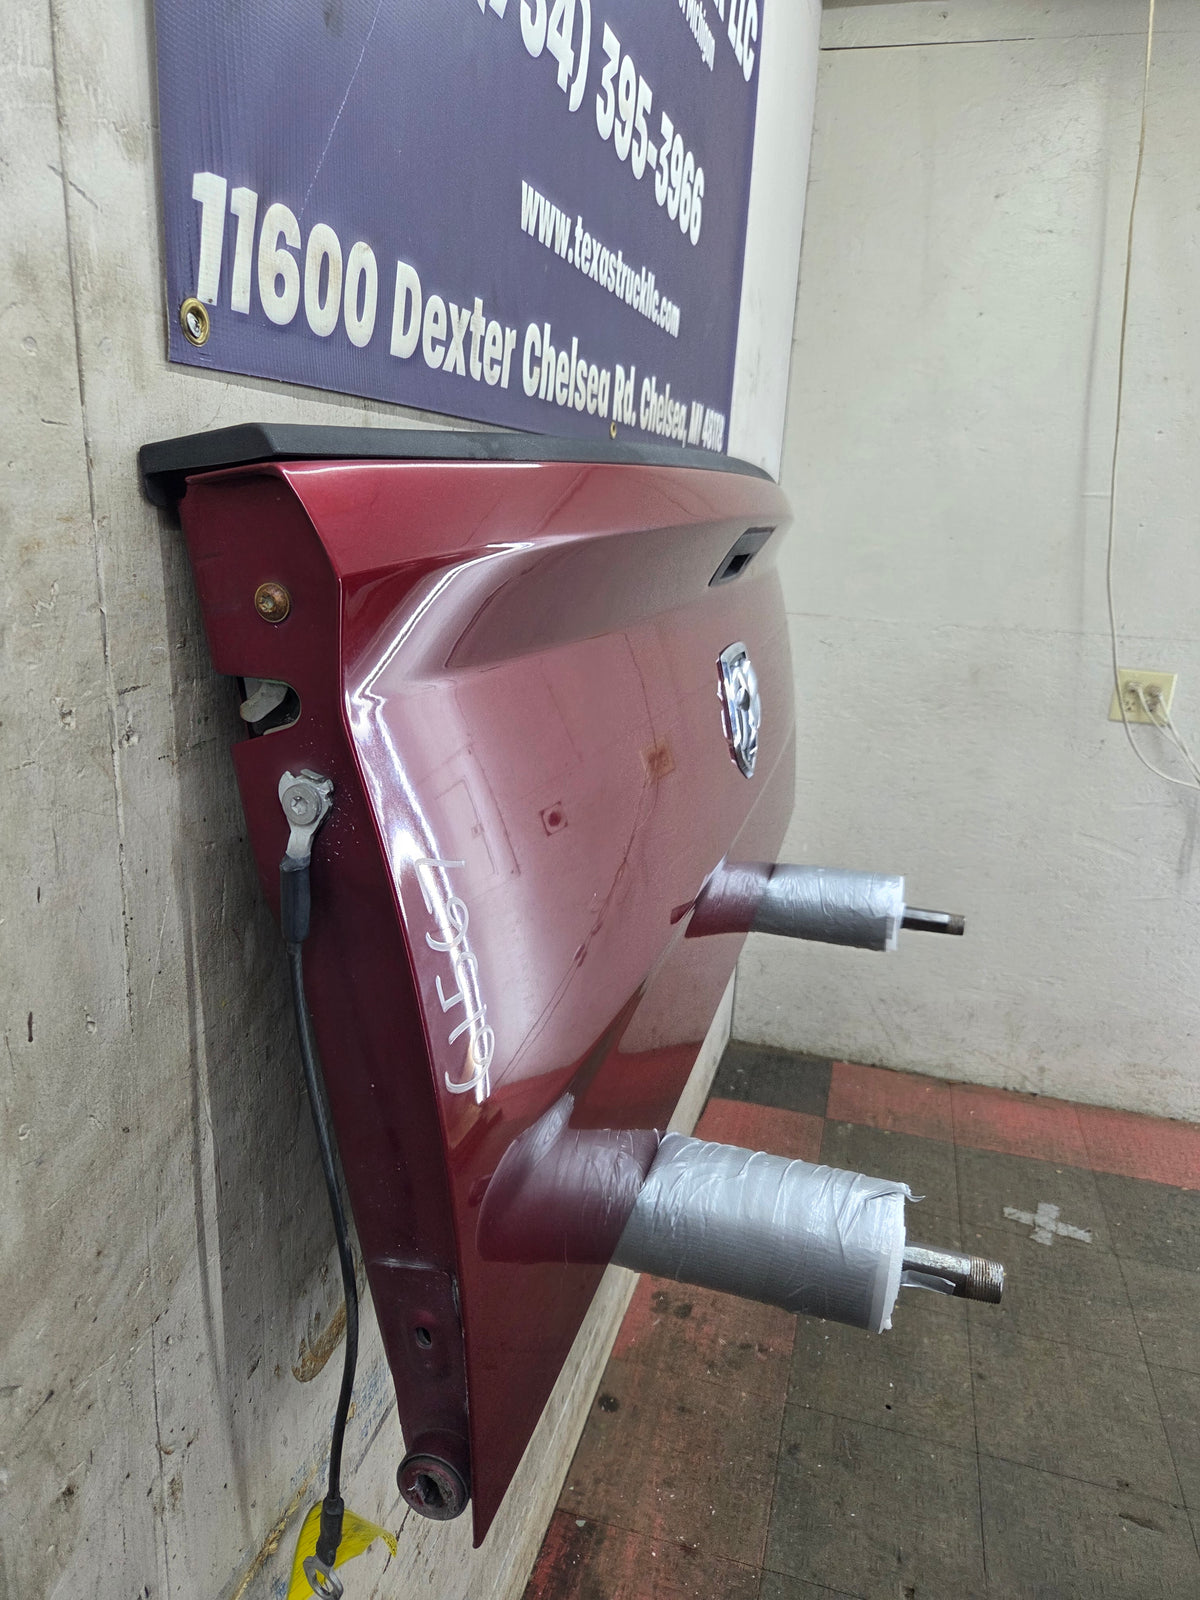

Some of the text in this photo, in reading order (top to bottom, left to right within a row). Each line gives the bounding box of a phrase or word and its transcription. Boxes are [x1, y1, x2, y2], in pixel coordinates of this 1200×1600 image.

[596, 21, 704, 246] 395-3966
[192, 171, 378, 348] 11600
[389, 259, 517, 389] Dexter
[522, 322, 610, 418] Chelsea
[612, 364, 637, 427] Rd.
[640, 376, 688, 448] Chelsea,
[520, 179, 680, 338] www.texastruckllc.com
